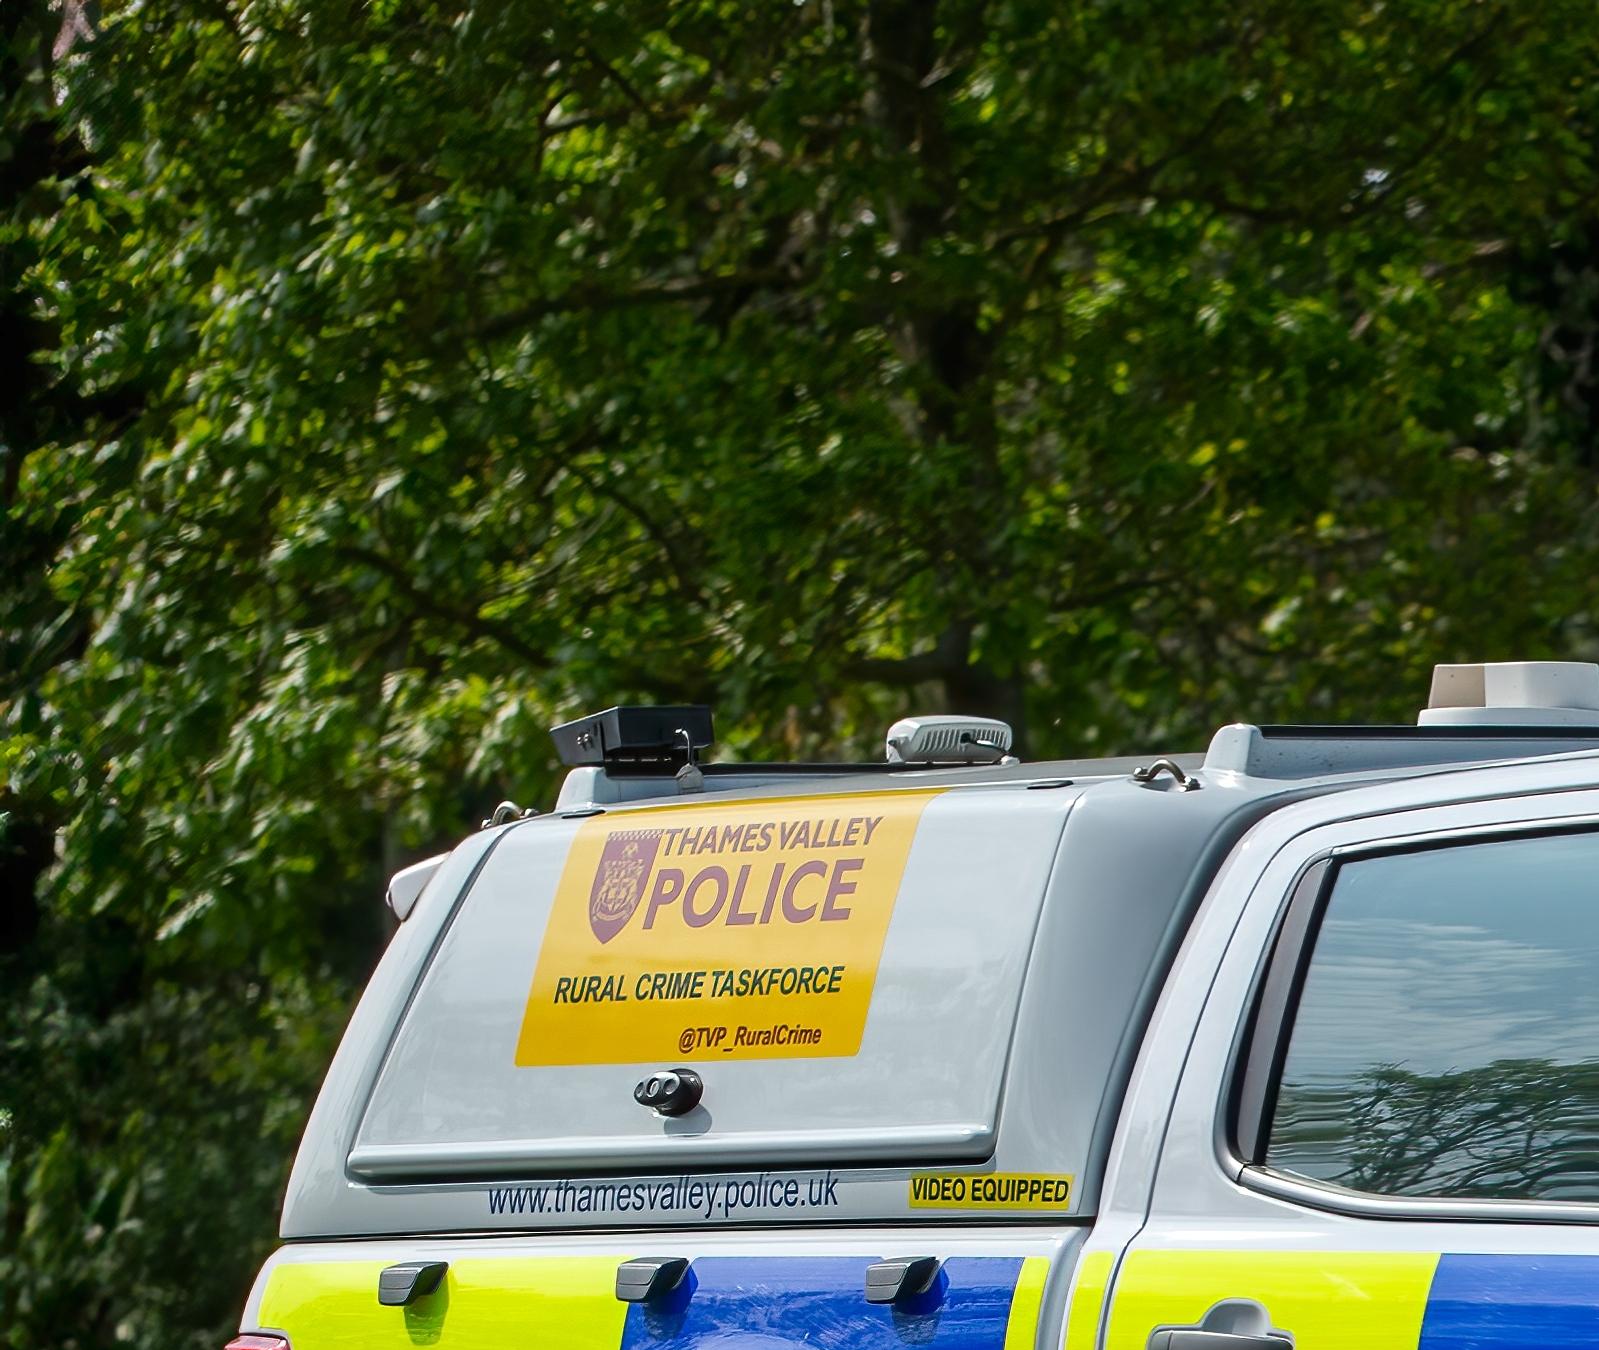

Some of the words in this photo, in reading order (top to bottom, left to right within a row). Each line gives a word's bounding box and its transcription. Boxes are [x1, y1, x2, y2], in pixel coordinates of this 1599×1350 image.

[662, 822, 777, 857] THAMES
[779, 816, 885, 851] VALLEY
[642, 858, 866, 931] POLICE
[554, 975, 628, 1004] RURAL
[634, 970, 705, 1001] CRIME
[711, 965, 846, 998] TASKFORCE
[678, 1024, 823, 1055] @TVP_RuralCrime
[487, 1171, 840, 1219] www.thamesvalley.police.uk
[911, 1177, 967, 1202] VIDEO
[970, 1178, 1070, 1204] EQUIPPED
